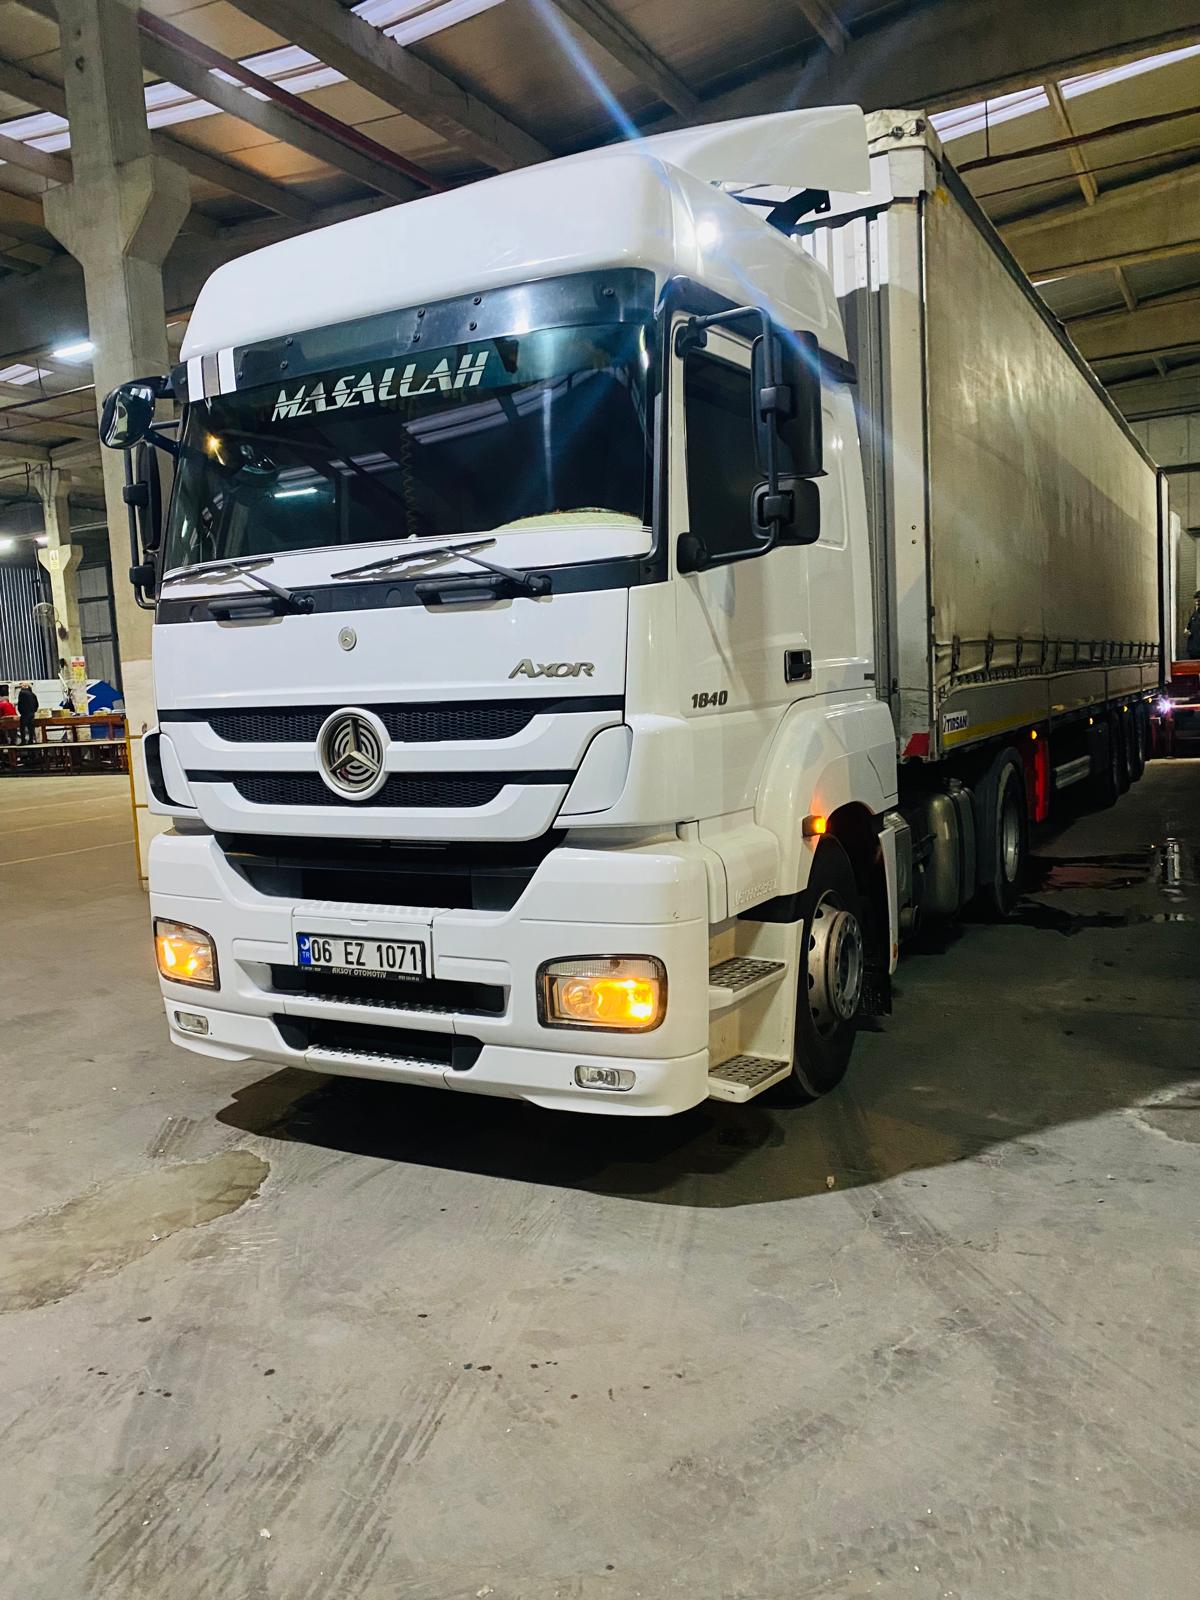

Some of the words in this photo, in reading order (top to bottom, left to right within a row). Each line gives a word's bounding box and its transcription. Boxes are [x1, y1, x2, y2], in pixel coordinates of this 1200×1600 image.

[271, 350, 490, 422] MASALLAH
[508, 658, 595, 679] AXOR
[691, 690, 729, 709] 1840
[311, 939, 332, 963] 06
[344, 941, 366, 967] EZ
[376, 944, 417, 971] 1071
